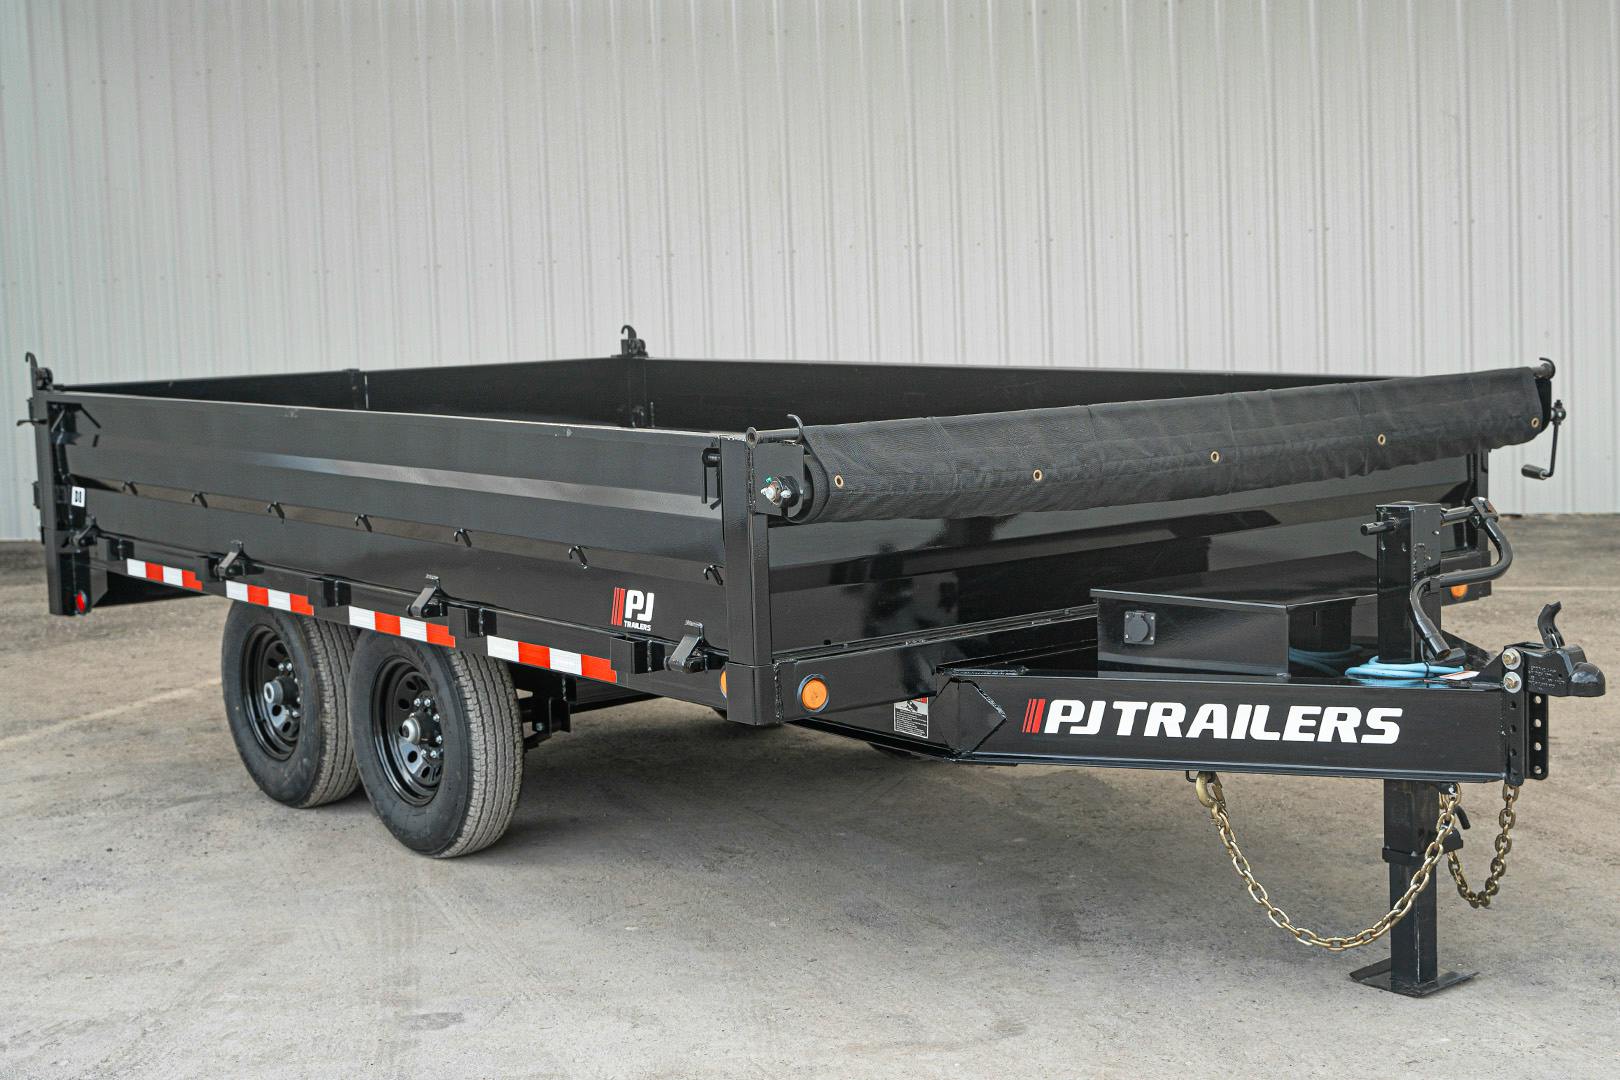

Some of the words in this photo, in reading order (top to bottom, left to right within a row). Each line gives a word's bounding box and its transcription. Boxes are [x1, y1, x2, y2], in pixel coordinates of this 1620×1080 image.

[625, 589, 655, 622] PJ
[624, 620, 652, 631] TRAILERS
[1112, 700, 1403, 745] TRAILERS
